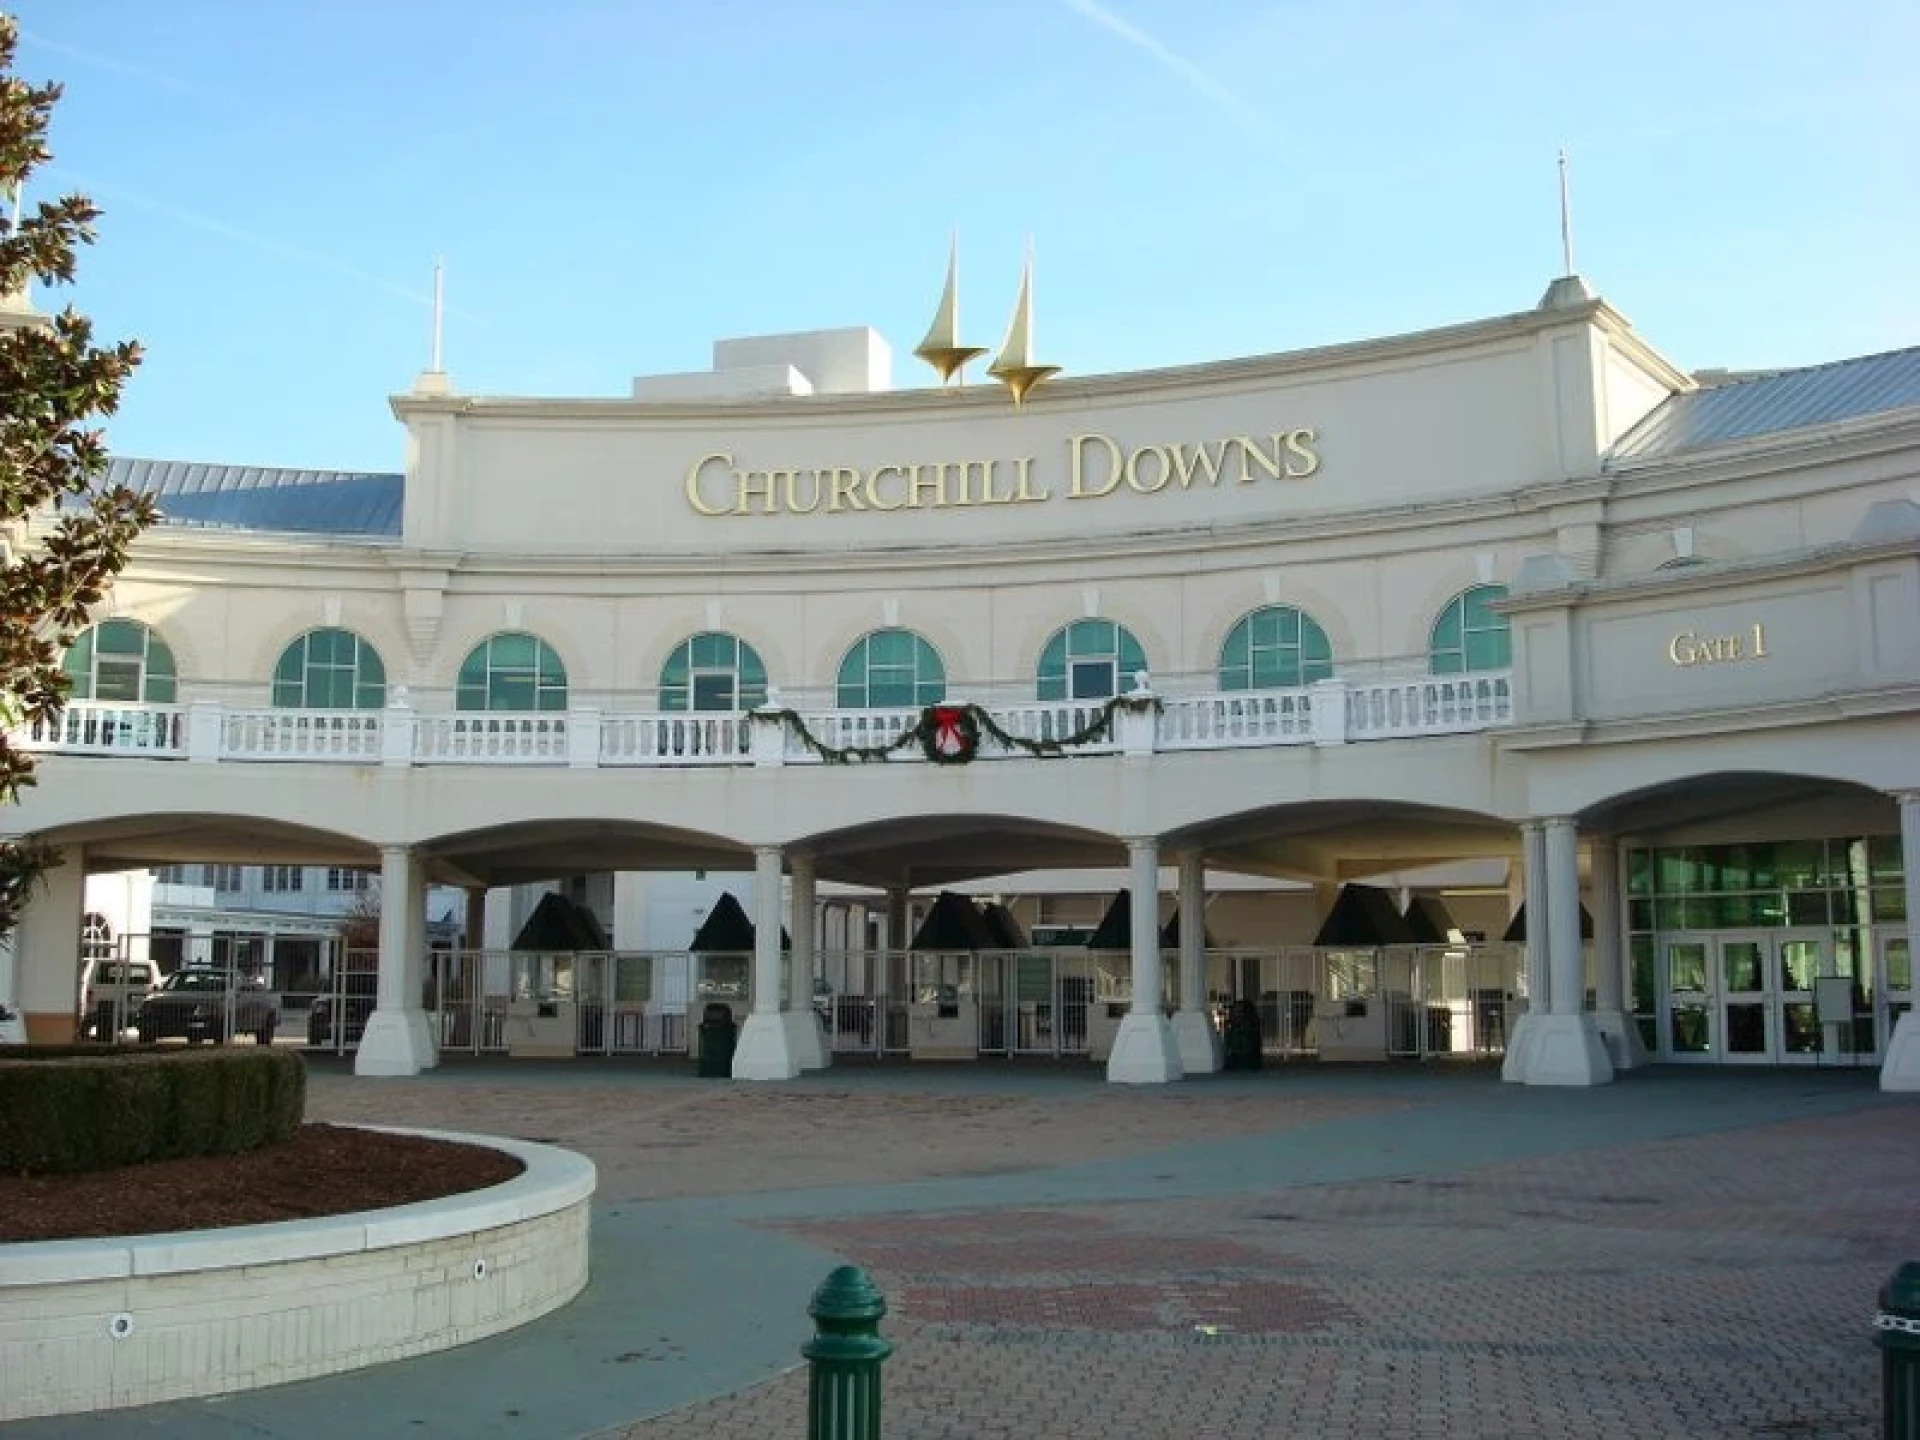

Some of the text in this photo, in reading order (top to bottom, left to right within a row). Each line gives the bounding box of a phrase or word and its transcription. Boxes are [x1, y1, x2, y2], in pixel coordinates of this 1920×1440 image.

[684, 428, 1322, 516] CHURCHILL DOWNS
[1669, 622, 1767, 667] GATE 1
